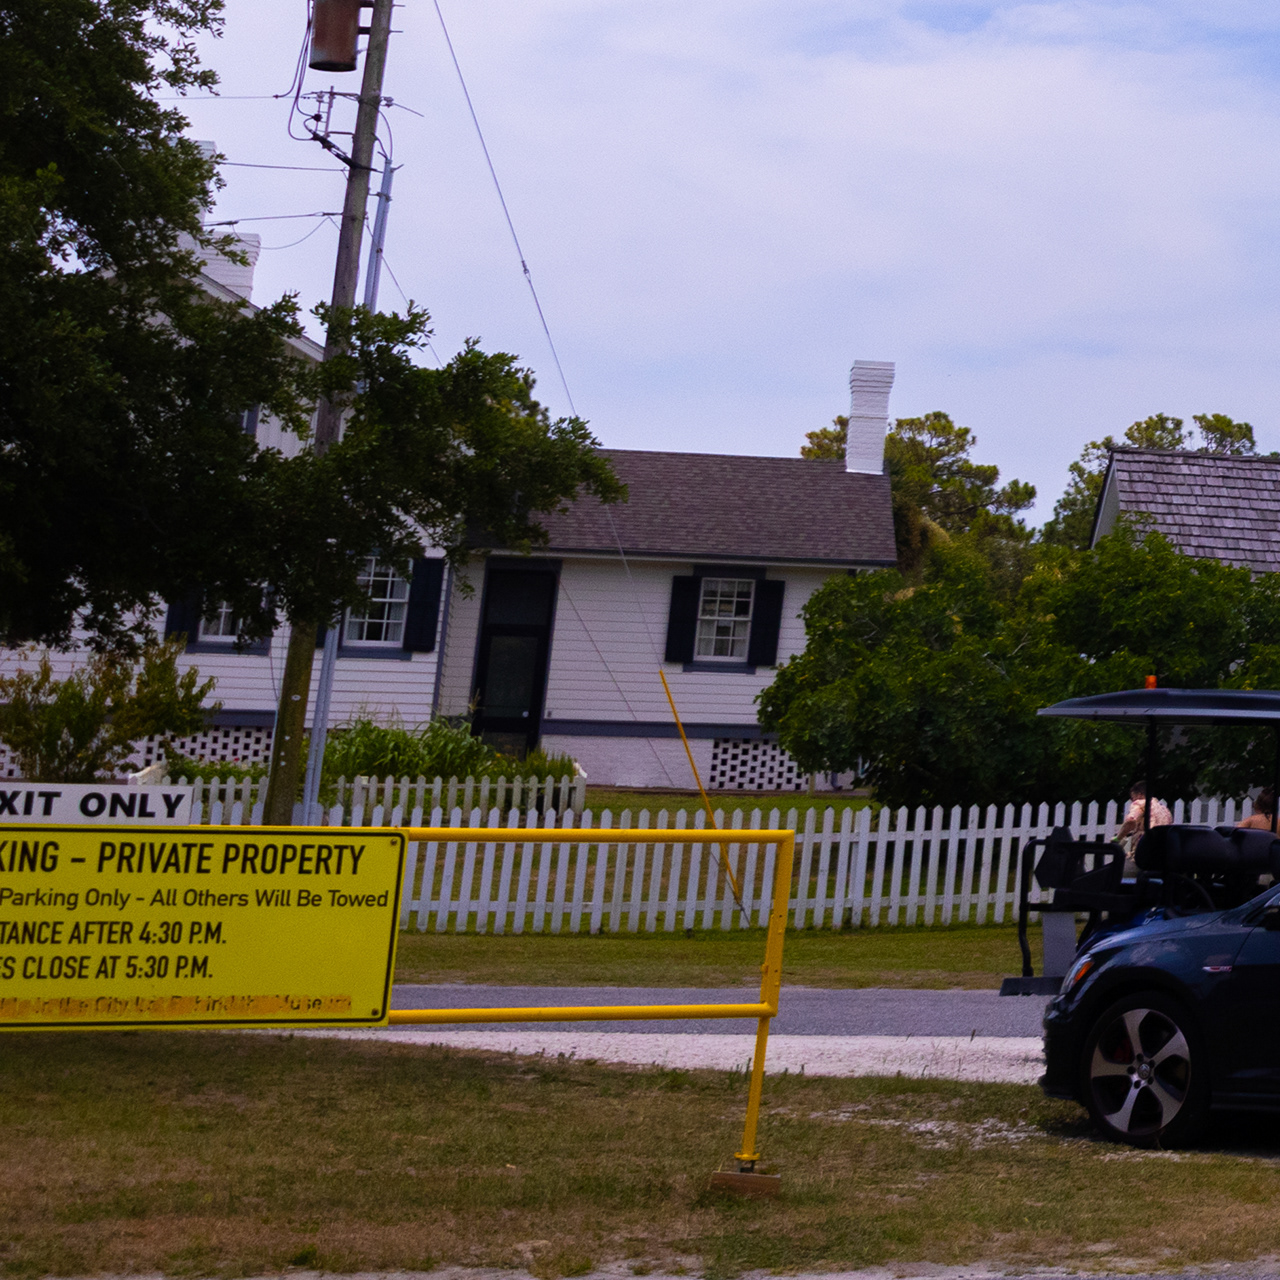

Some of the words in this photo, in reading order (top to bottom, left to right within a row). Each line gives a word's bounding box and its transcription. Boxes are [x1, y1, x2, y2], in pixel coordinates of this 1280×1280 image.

[0, 790, 62, 816] XIT
[79, 792, 186, 818] ONLY
[97, 841, 214, 874] PRIVATE
[222, 843, 366, 875] PROPERTY
[0, 887, 79, 911] Parking
[85, 888, 131, 911] Only
[149, 888, 177, 907] All
[183, 888, 249, 907] Others
[255, 889, 291, 907] Will
[297, 889, 322, 907] Be
[328, 889, 389, 907] Towed
[68, 921, 133, 945] AFTER
[139, 921, 183, 945] 4:30
[188, 921, 227, 945] P.M.
[22, 956, 91, 980] CLOSE
[95, 956, 121, 979] AT
[125, 955, 170, 979] 5:30
[175, 955, 213, 979] P.M.
